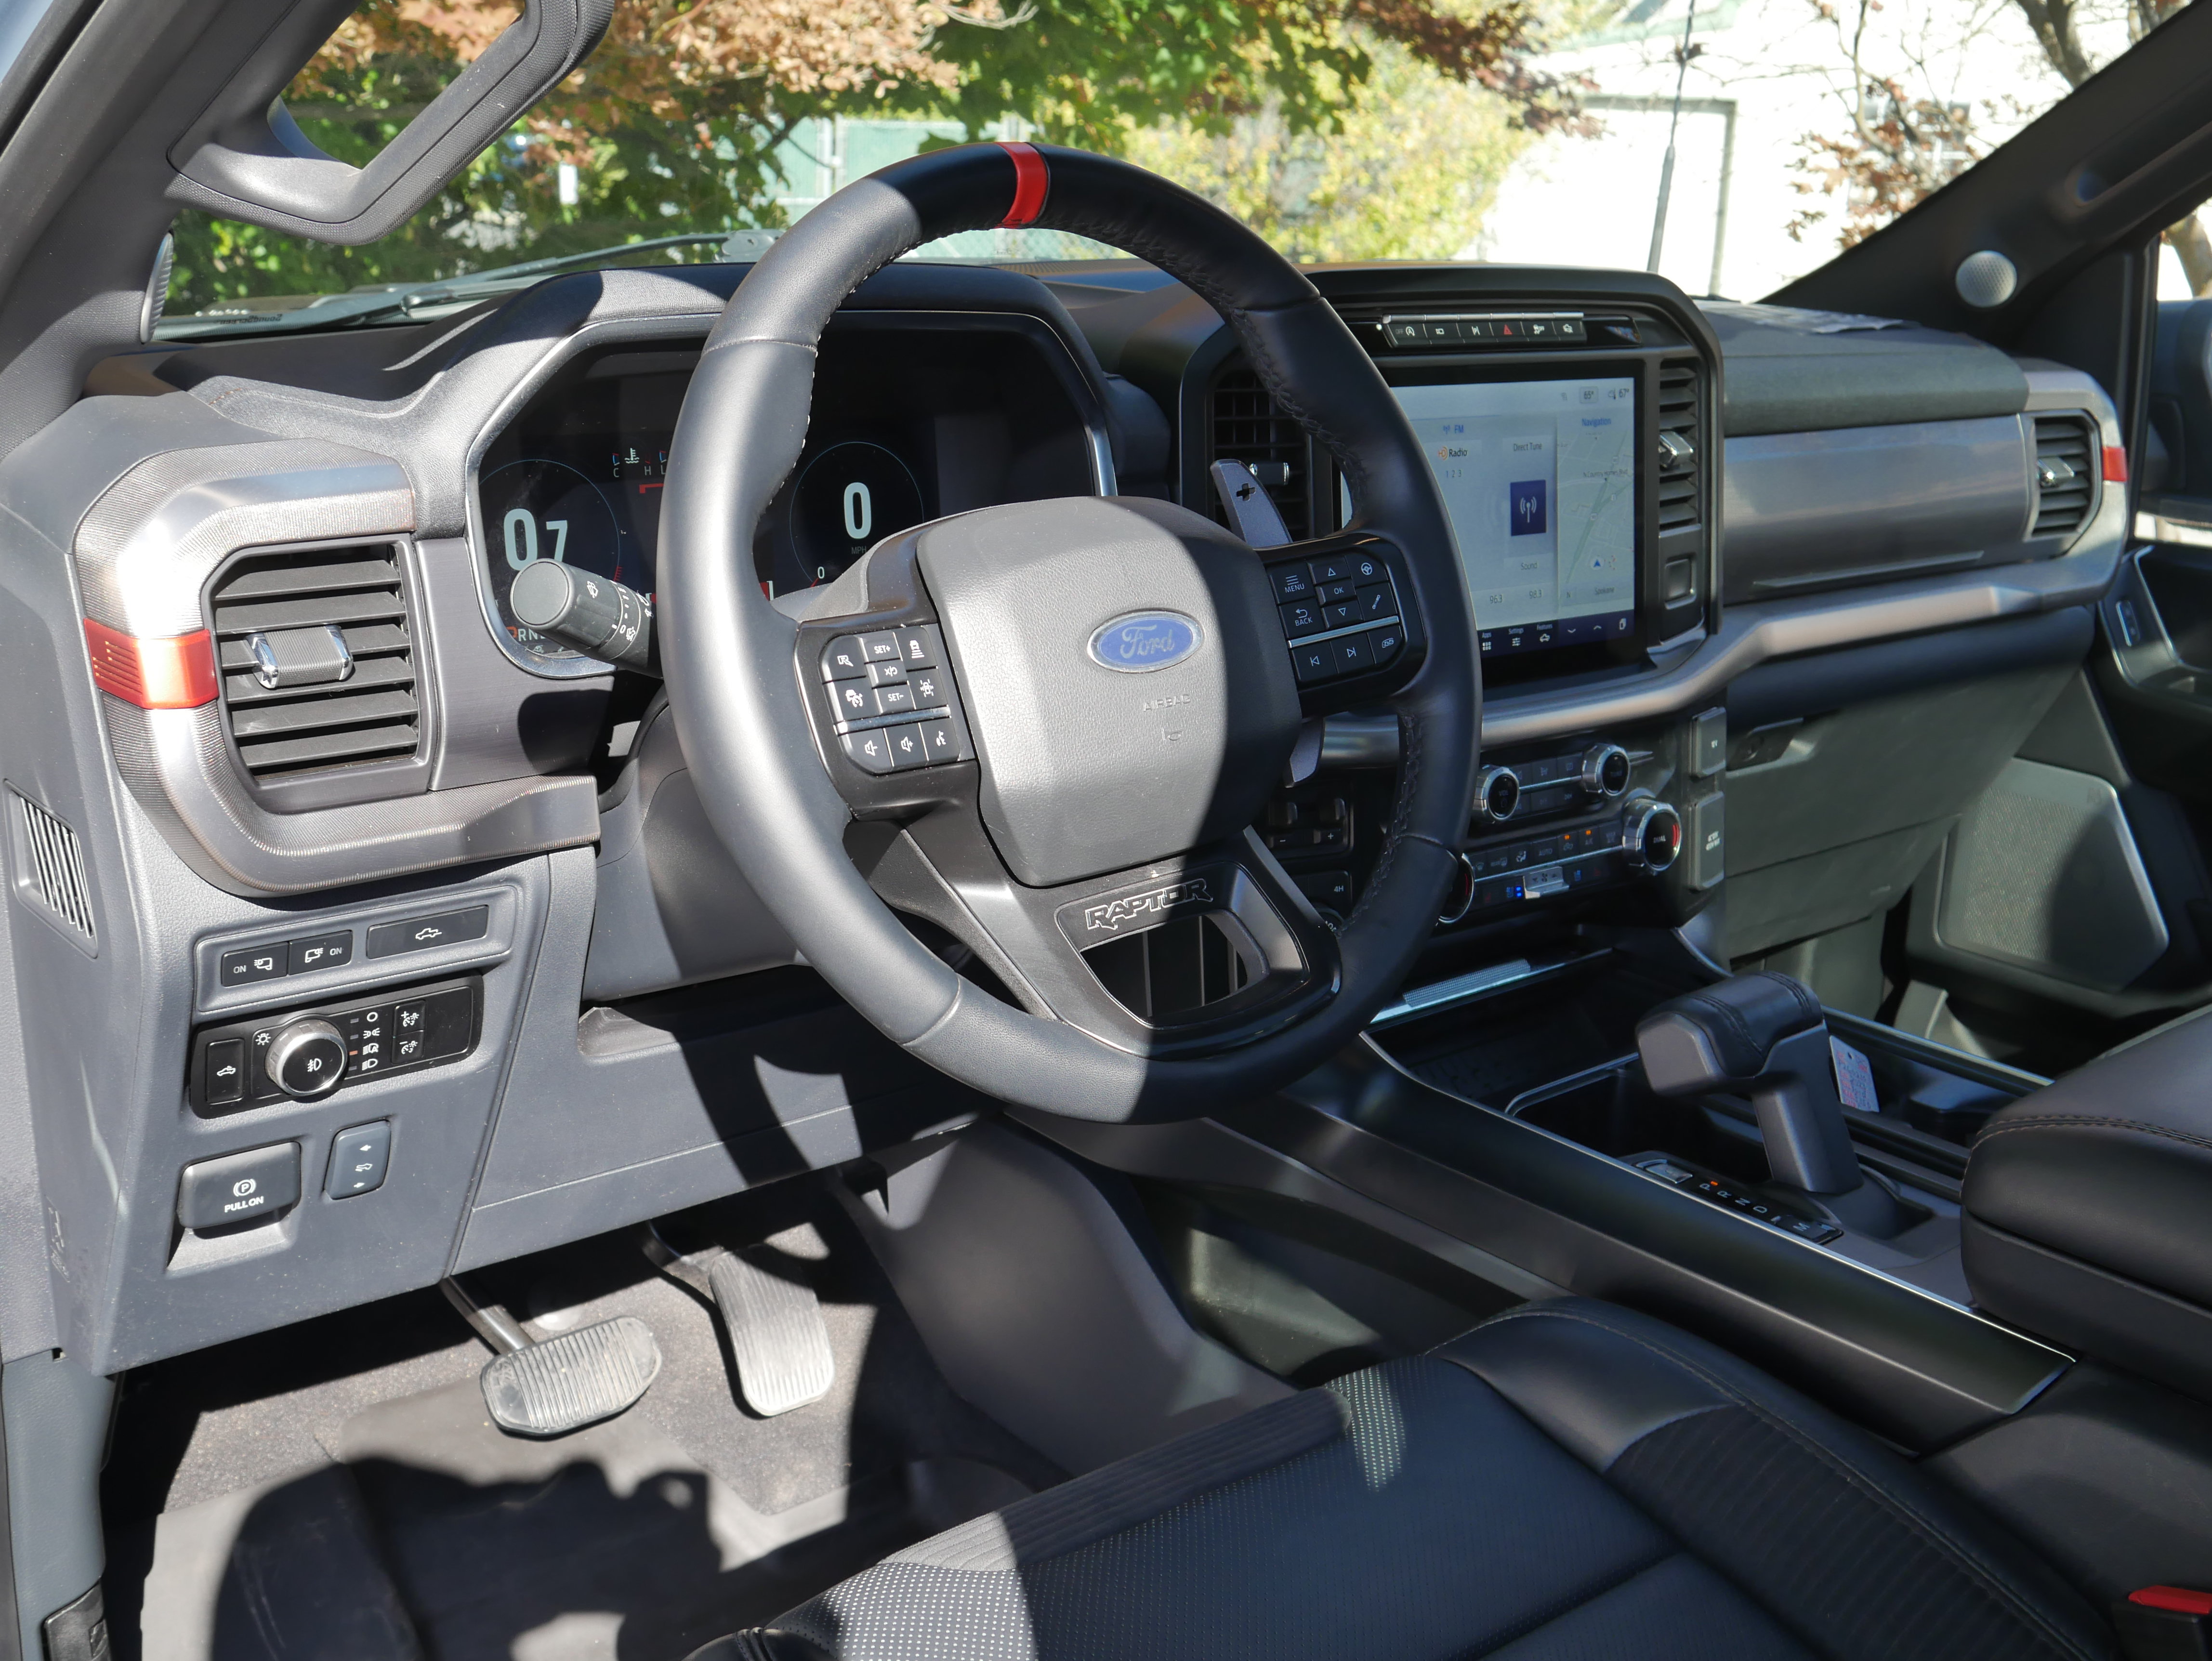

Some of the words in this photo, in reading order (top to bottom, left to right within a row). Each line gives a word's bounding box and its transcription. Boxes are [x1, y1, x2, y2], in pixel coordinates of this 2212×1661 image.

[1581, 418, 1611, 427] Navigation
[1454, 425, 1464, 434] FM
[1514, 443, 1528, 451] Direct
[1529, 442, 1542, 450] Tune
[1449, 448, 1468, 457] Radio
[613, 468, 619, 477] C
[644, 466, 652, 475] H
[1452, 470, 1455, 478] 2
[843, 482, 871, 539] 0
[851, 546, 867, 554] MPH
[1520, 562, 1538, 570] Sound
[817, 567, 825, 579] 0
[1285, 583, 1304, 593] MENU
[1595, 586, 1615, 595] Spokane
[1529, 590, 1542, 599] 98.3
[1490, 595, 1502, 604] 96.3
[1295, 617, 1313, 626] BACK
[1120, 624, 1175, 659] Ford
[1143, 693, 1191, 712] AIRBAG
[1085, 878, 1214, 930] RAPTOR
[329, 947, 342, 956] ON
[233, 965, 246, 974] ON
[224, 1199, 248, 1213] PULL
[248, 1196, 264, 1207] ON
[1717, 1190, 1732, 1199] R
[1752, 1206, 1768, 1214] D
[1792, 1222, 1810, 1232] M
